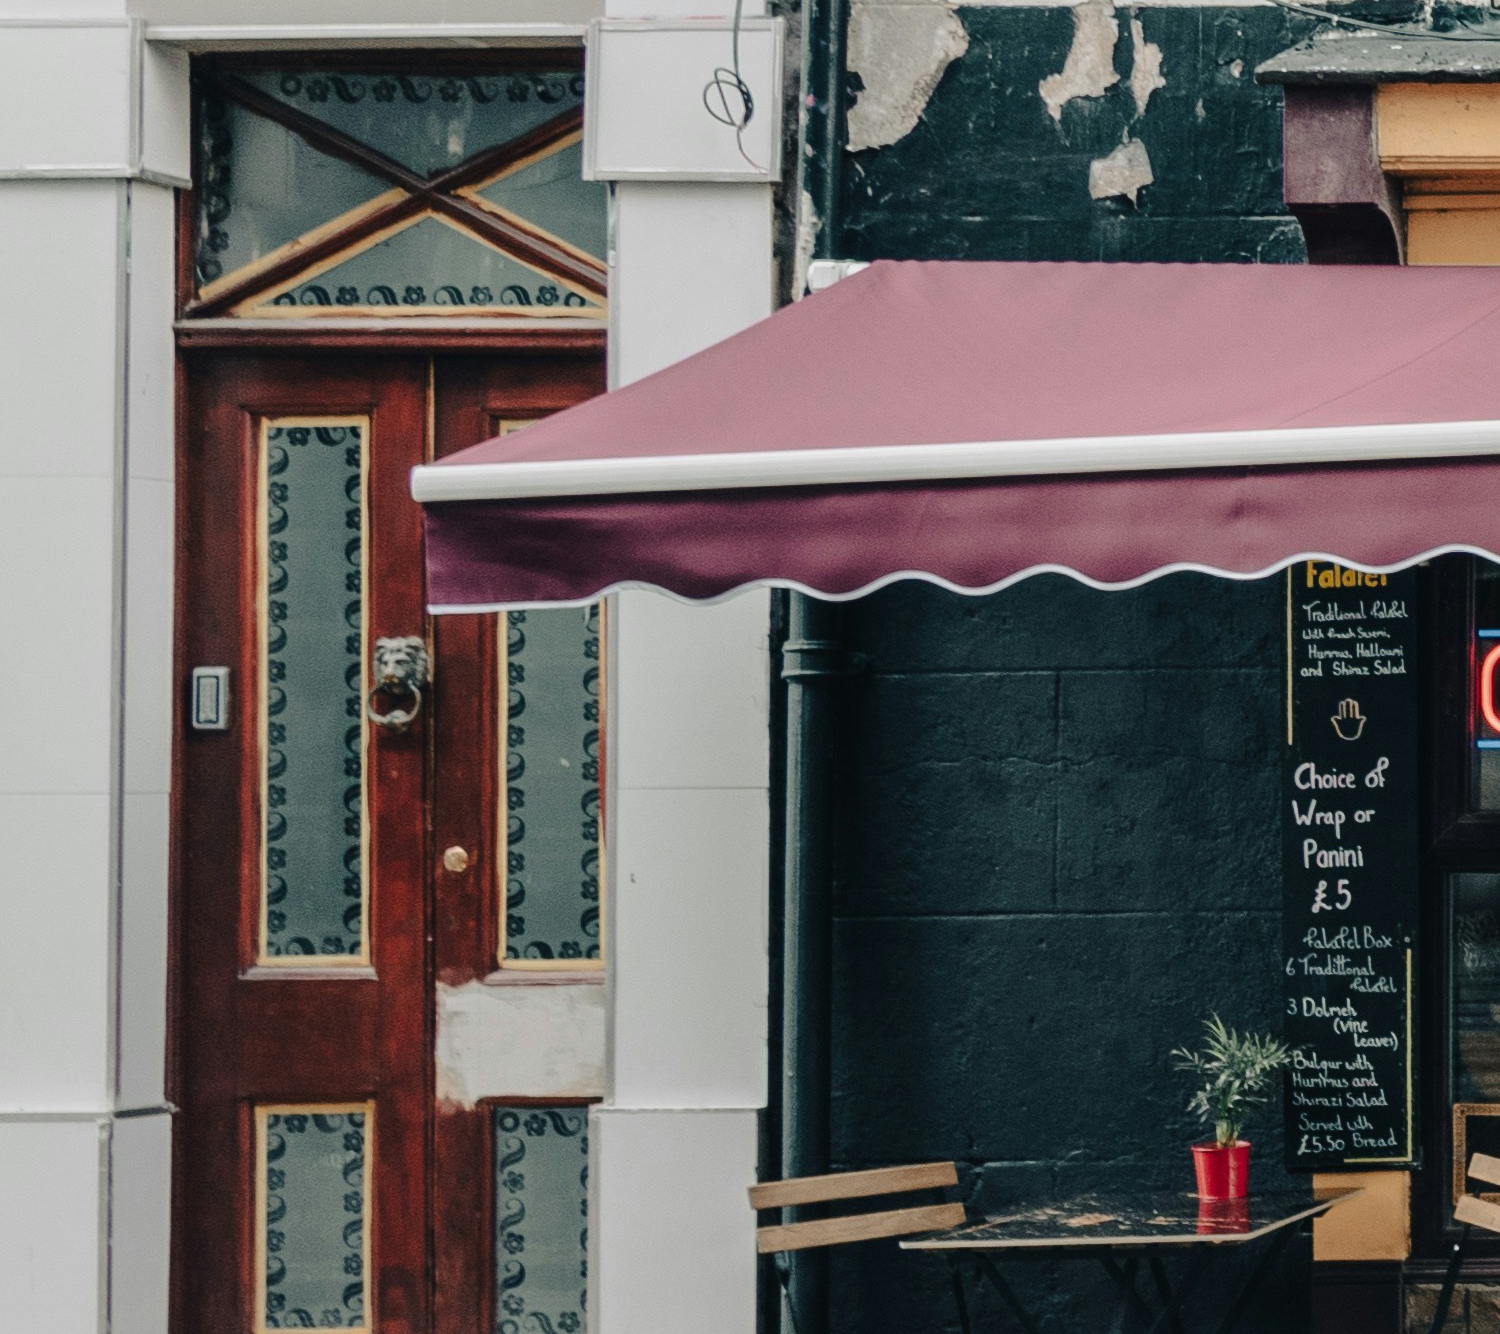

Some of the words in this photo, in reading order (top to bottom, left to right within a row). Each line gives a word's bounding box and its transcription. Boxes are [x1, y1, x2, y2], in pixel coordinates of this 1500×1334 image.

[1302, 600, 1368, 622] Traditional
[1356, 643, 1404, 658] Halloumi
[1300, 661, 1324, 677] and
[1332, 662, 1371, 676] Shiraz
[1373, 659, 1407, 675] Salad
[1294, 762, 1356, 790] Choice
[1365, 756, 1390, 788] of
[1292, 798, 1346, 840] Wrap
[1354, 810, 1376, 824] or
[1303, 838, 1364, 869] Panini
[1311, 879, 1352, 913] £5
[1364, 926, 1392, 948] Box
[1286, 957, 1296, 976] 6
[1287, 998, 1297, 1015] 3
[1302, 996, 1357, 1017] Dolmeh
[1333, 1017, 1369, 1034] (vine
[1293, 1050, 1343, 1077] Bulgur
[1345, 1054, 1374, 1070] with
[1352, 1072, 1378, 1086] and
[1292, 1092, 1342, 1106] Shirazi
[1346, 1089, 1388, 1107] Salad
[1299, 1113, 1343, 1131] Served
[1297, 1135, 1346, 1155] £5.50
[1353, 1127, 1397, 1147] Bread
